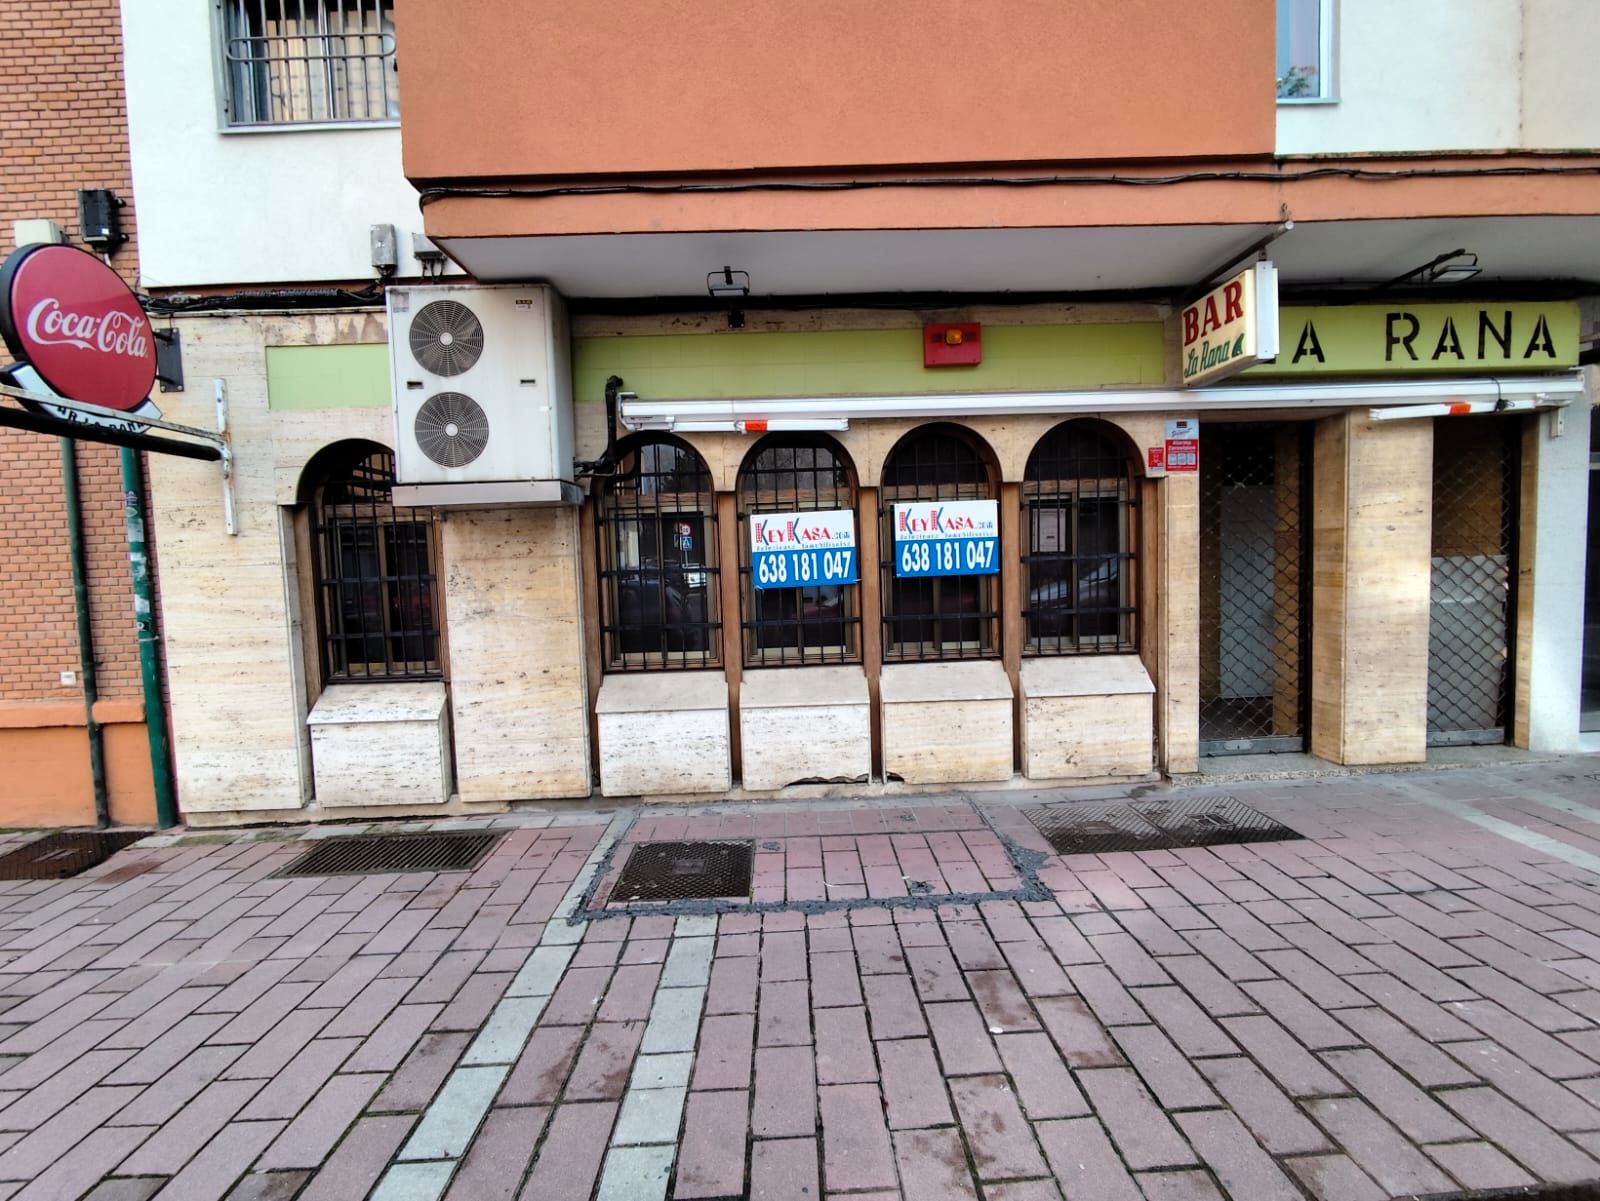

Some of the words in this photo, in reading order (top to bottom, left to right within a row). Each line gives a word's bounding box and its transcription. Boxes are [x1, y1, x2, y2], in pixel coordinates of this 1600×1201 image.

[27, 298, 148, 357] Coca-Cola
[1183, 281, 1244, 347] BAR
[1262, 320, 1326, 364] A
[1385, 310, 1557, 362] RANA
[1184, 348, 1199, 378] La
[1200, 340, 1231, 371] Rana
[759, 553, 788, 584] 638
[792, 552, 818, 582] 181
[823, 550, 852, 580] 047
[902, 543, 931, 572] 638
[935, 541, 961, 570] 181
[966, 540, 995, 570] 047
